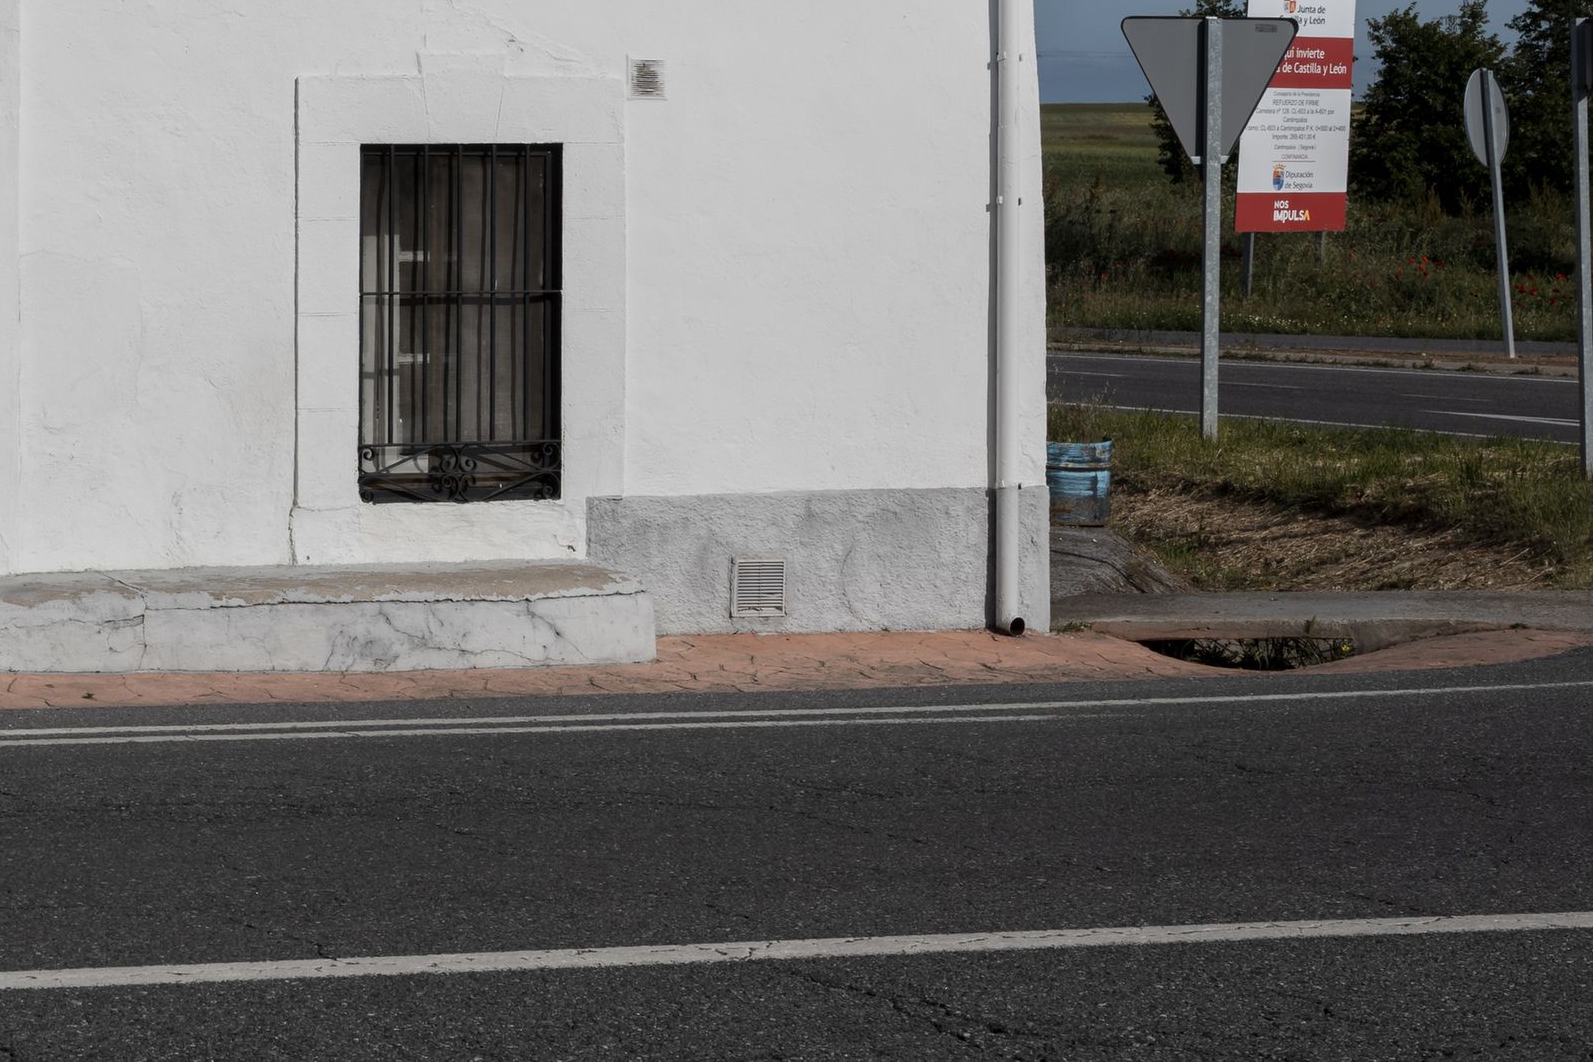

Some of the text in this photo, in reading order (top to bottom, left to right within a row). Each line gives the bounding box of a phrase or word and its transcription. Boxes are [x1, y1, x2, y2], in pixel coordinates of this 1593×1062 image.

[1297, 5, 1326, 14] Junta de
[1309, 17, 1326, 25] León
[1296, 47, 1325, 59] invierte
[1282, 62, 1292, 73] de
[1293, 62, 1321, 74] Castilla
[1323, 66, 1328, 76] y
[1329, 62, 1347, 74] León
[1285, 171, 1313, 179] Diputación
[1292, 182, 1313, 190] Segovia
[1274, 200, 1289, 209] NOS
[1273, 210, 1310, 223] IMPULSA
